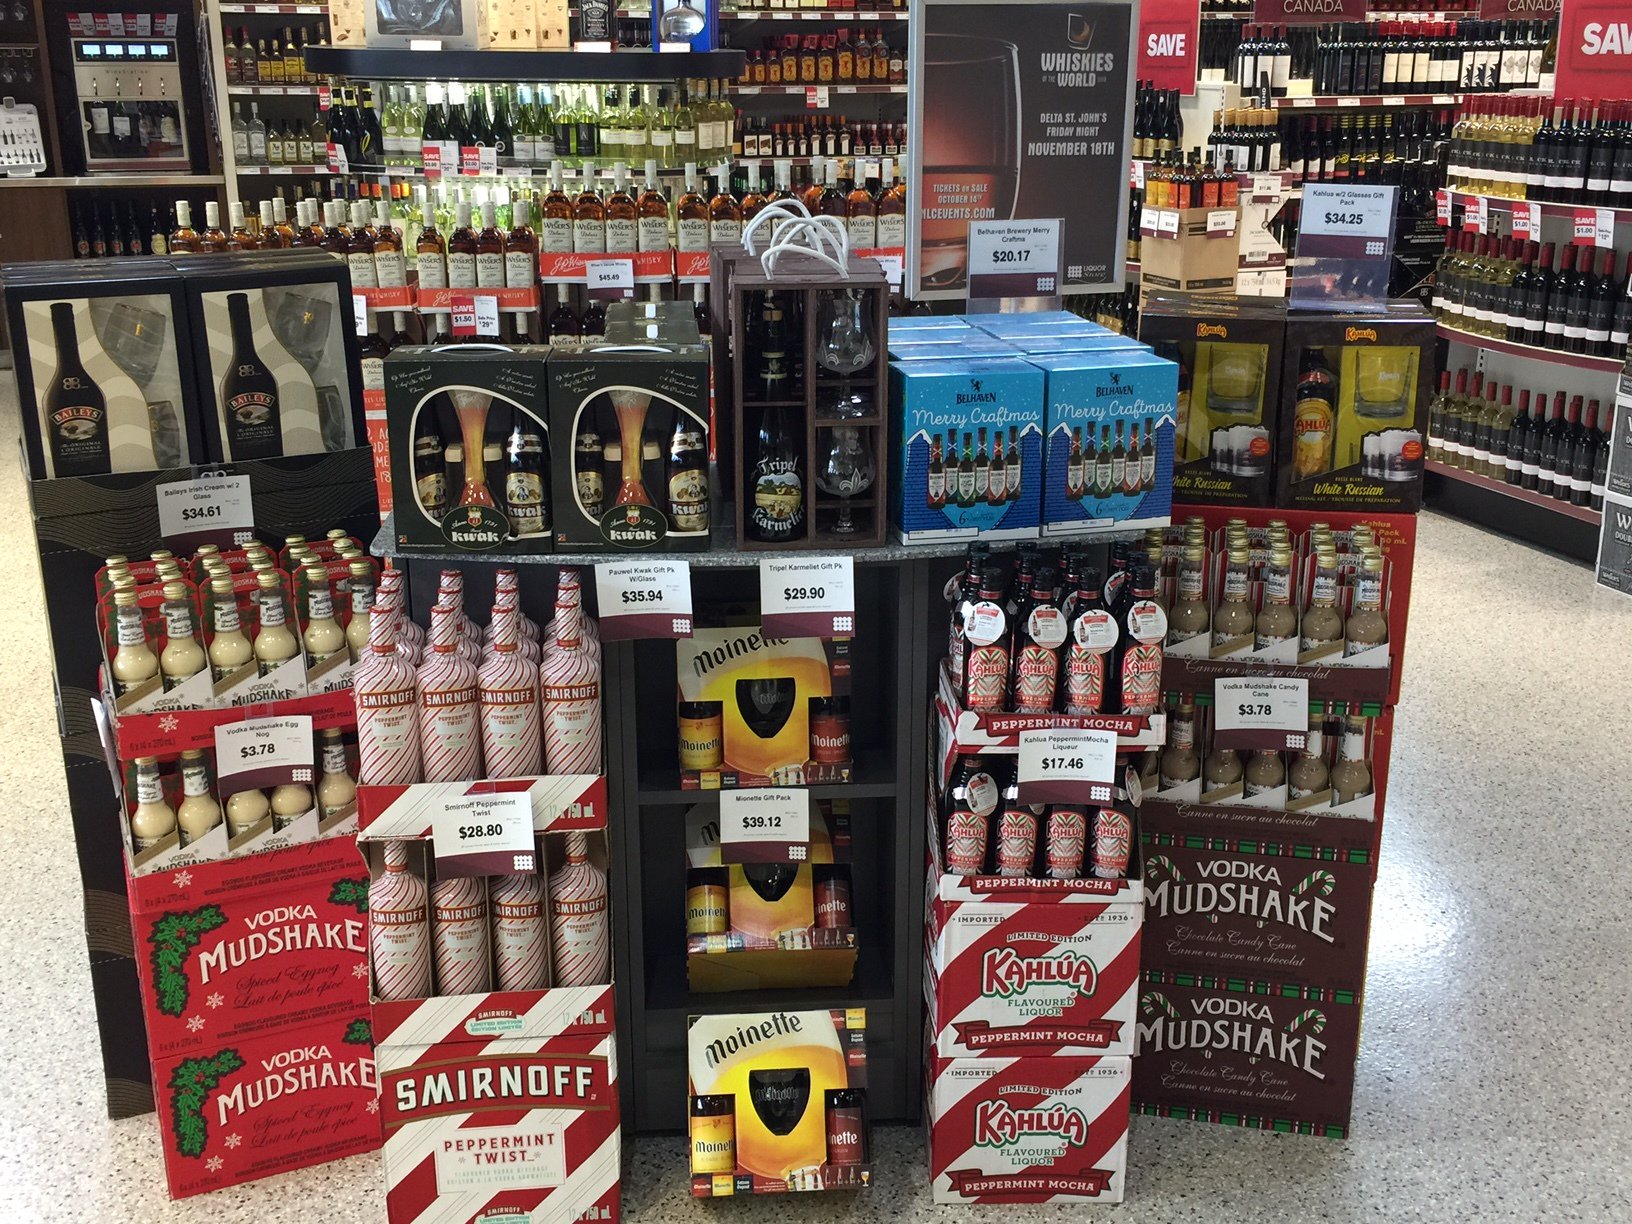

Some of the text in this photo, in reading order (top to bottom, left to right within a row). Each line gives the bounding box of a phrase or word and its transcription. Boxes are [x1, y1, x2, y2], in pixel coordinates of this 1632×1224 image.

[1283, 0, 1344, 13] CANADA
[1147, 33, 1186, 57] SAVE
[1041, 53, 1114, 71] WHISKIES
[1058, 73, 1096, 87] WORLD
[1040, 113, 1107, 123] DELTA ST. JOHN'S
[1047, 127, 1099, 136] FRIDAY NIGHT
[1028, 142, 1114, 156] NOVEMBER 18TH
[933, 184, 960, 193] TICKETS
[971, 184, 988, 192] SALE
[1312, 190, 1333, 199] Kahlua
[1347, 191, 1372, 199] Glasses
[938, 195, 968, 204] OCTOBER
[1325, 212, 1363, 225] $34.25
[977, 227, 1050, 236] Belhaven Brewery Merry
[637, 257, 662, 265] WHISKY
[992, 250, 1030, 263] $20.17
[453, 305, 474, 313] SAVE
[1096, 385, 1134, 398] BELHAVEN
[228, 393, 272, 408] BAILEYS
[957, 392, 997, 405] BELHAVEN
[54, 407, 100, 422] BAILEYS
[1054, 399, 1174, 421] Merry Craftmas
[912, 407, 1040, 429] Merry Craftmas
[757, 456, 798, 475] Tripel
[1194, 477, 1232, 490] Russian
[1313, 483, 1385, 496] White Russian
[164, 488, 187, 497] Baileys
[188, 485, 203, 493] Irish
[193, 493, 212, 501] Glass
[182, 505, 222, 521] $34.61
[451, 531, 500, 543] kwak
[609, 530, 658, 542] kwak
[609, 568, 632, 576] Pauwel
[653, 567, 664, 575] Gift
[768, 564, 787, 572] Tripel
[835, 562, 842, 570] Pk
[622, 589, 663, 604] $35.94
[783, 587, 825, 601] $29.90
[248, 683, 275, 691] VODKA
[546, 685, 596, 699] SMIRNOFF
[1244, 683, 1277, 691] Mudshake
[1278, 684, 1299, 692] Candy
[231, 688, 294, 707] MUDSHAKE
[362, 690, 415, 706] SMIRNOFF
[426, 689, 477, 705] SMIRNOFF
[481, 691, 532, 703] SMIRNOFF
[1238, 704, 1272, 717] $3.78
[226, 721, 299, 736] Vodka Mudshake Egg
[992, 718, 1134, 731] PEPPERMINT MOCHA
[255, 731, 270, 739] Nog
[1048, 736, 1109, 744] PeppermintMocha
[240, 743, 275, 759] $3.78
[1041, 758, 1084, 771] $17.46
[445, 799, 516, 812] Smirnoff Peppermint
[742, 816, 781, 829] $39.12
[459, 824, 503, 840] $28.80
[1196, 860, 1282, 887] VODKA
[976, 879, 1112, 890] PEPPERMINT MOCHA
[437, 904, 486, 921] SMIRNOFF
[555, 900, 604, 914] SMIRNOFF
[1143, 880, 1336, 943] MUDSHAKE
[244, 904, 318, 931] VODKA
[373, 908, 423, 923] SMIRNOFF
[1007, 931, 1092, 943] LIMITED EDITION
[1175, 926, 1297, 950] Chocolate Candy Cane
[198, 918, 366, 985] MUDSHAKE
[1165, 939, 1203, 955] Canne
[1219, 951, 1245, 961] sucre
[1262, 952, 1306, 968] chocolat
[985, 949, 1097, 994] KAHLÚA
[236, 971, 282, 994] Spiced
[1007, 996, 1076, 1008] FLAVOURED
[478, 1010, 513, 1019] SMIRNOFF
[1019, 1008, 1063, 1016] LIQUOR
[1190, 998, 1275, 1025] VODKA
[705, 1012, 803, 1069] Moinette
[971, 1031, 1104, 1044] PEPPERMINT MOCHA
[1133, 1016, 1327, 1080] MUDSHAKE
[261, 1045, 332, 1072] VODKA
[217, 1057, 377, 1127] MUDSHAKE
[396, 1065, 593, 1111] SMIRNOFF
[999, 1085, 1082, 1096] LIMITED EDITION
[978, 1102, 1086, 1145] KAHLÚA
[444, 1133, 556, 1152] PEPPERMINT
[474, 1150, 528, 1165] TWIST
[1000, 1147, 1066, 1157] FLAVOURED
[1011, 1157, 1054, 1166] LIQUOR
[965, 1180, 1095, 1192] PEPPERMINT MOCHA
